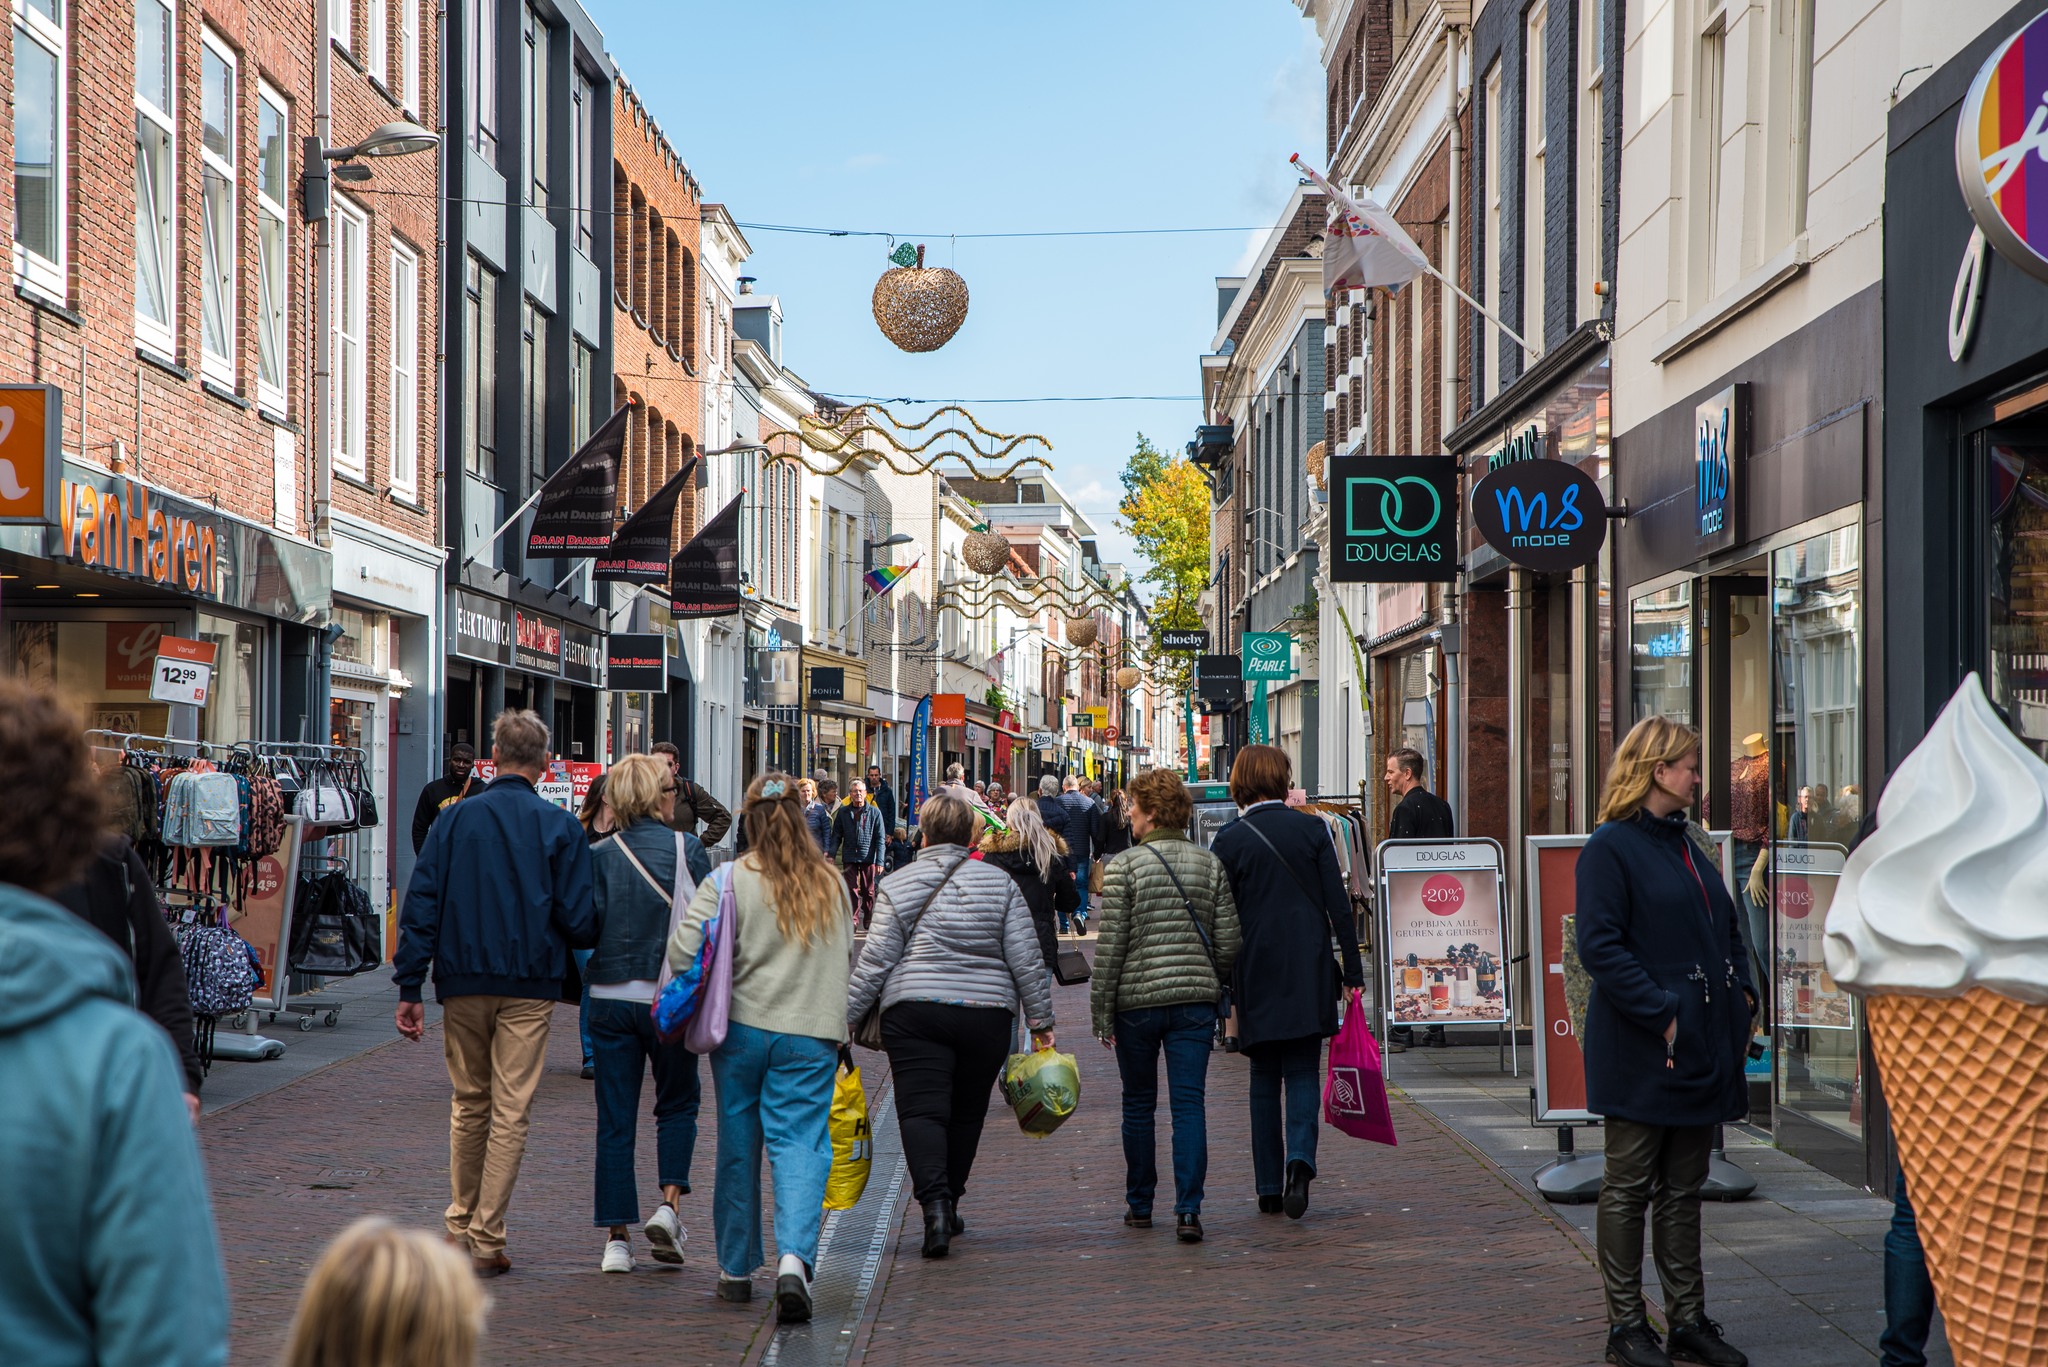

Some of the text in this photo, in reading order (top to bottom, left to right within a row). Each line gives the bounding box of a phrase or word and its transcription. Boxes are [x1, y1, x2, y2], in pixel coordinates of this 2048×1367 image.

[570, 510, 612, 520] DANSEN
[60, 477, 216, 595] vanHaren
[531, 535, 610, 545] DAAN DANSEN
[1346, 543, 1441, 561] DOUGLAS
[596, 559, 667, 571] DAAN DANSEN
[703, 560, 737, 569] DANSEN
[674, 581, 738, 592] DAAN DANSEN
[673, 601, 700, 610] DAAN
[458, 608, 510, 647] ELEKTRONICA
[516, 611, 560, 657] DAAN DANSEN
[1163, 633, 1204, 646] shoeby
[177, 645, 197, 655] Vanaf
[564, 640, 602, 670] ELEKTRONICA
[609, 657, 662, 665] DAAN DANSEN
[1248, 657, 1286, 672] PEARLE
[117, 673, 152, 683] vanHa
[162, 667, 197, 685] 12.99
[1033, 733, 1051, 744] Etos
[542, 786, 570, 794] Apple
[1416, 851, 1465, 861] DOUGLAS
[1410, 919, 1479, 928] OP BIJNA ALLE
[1395, 928, 1495, 938] GEUREN & GEURSETS
